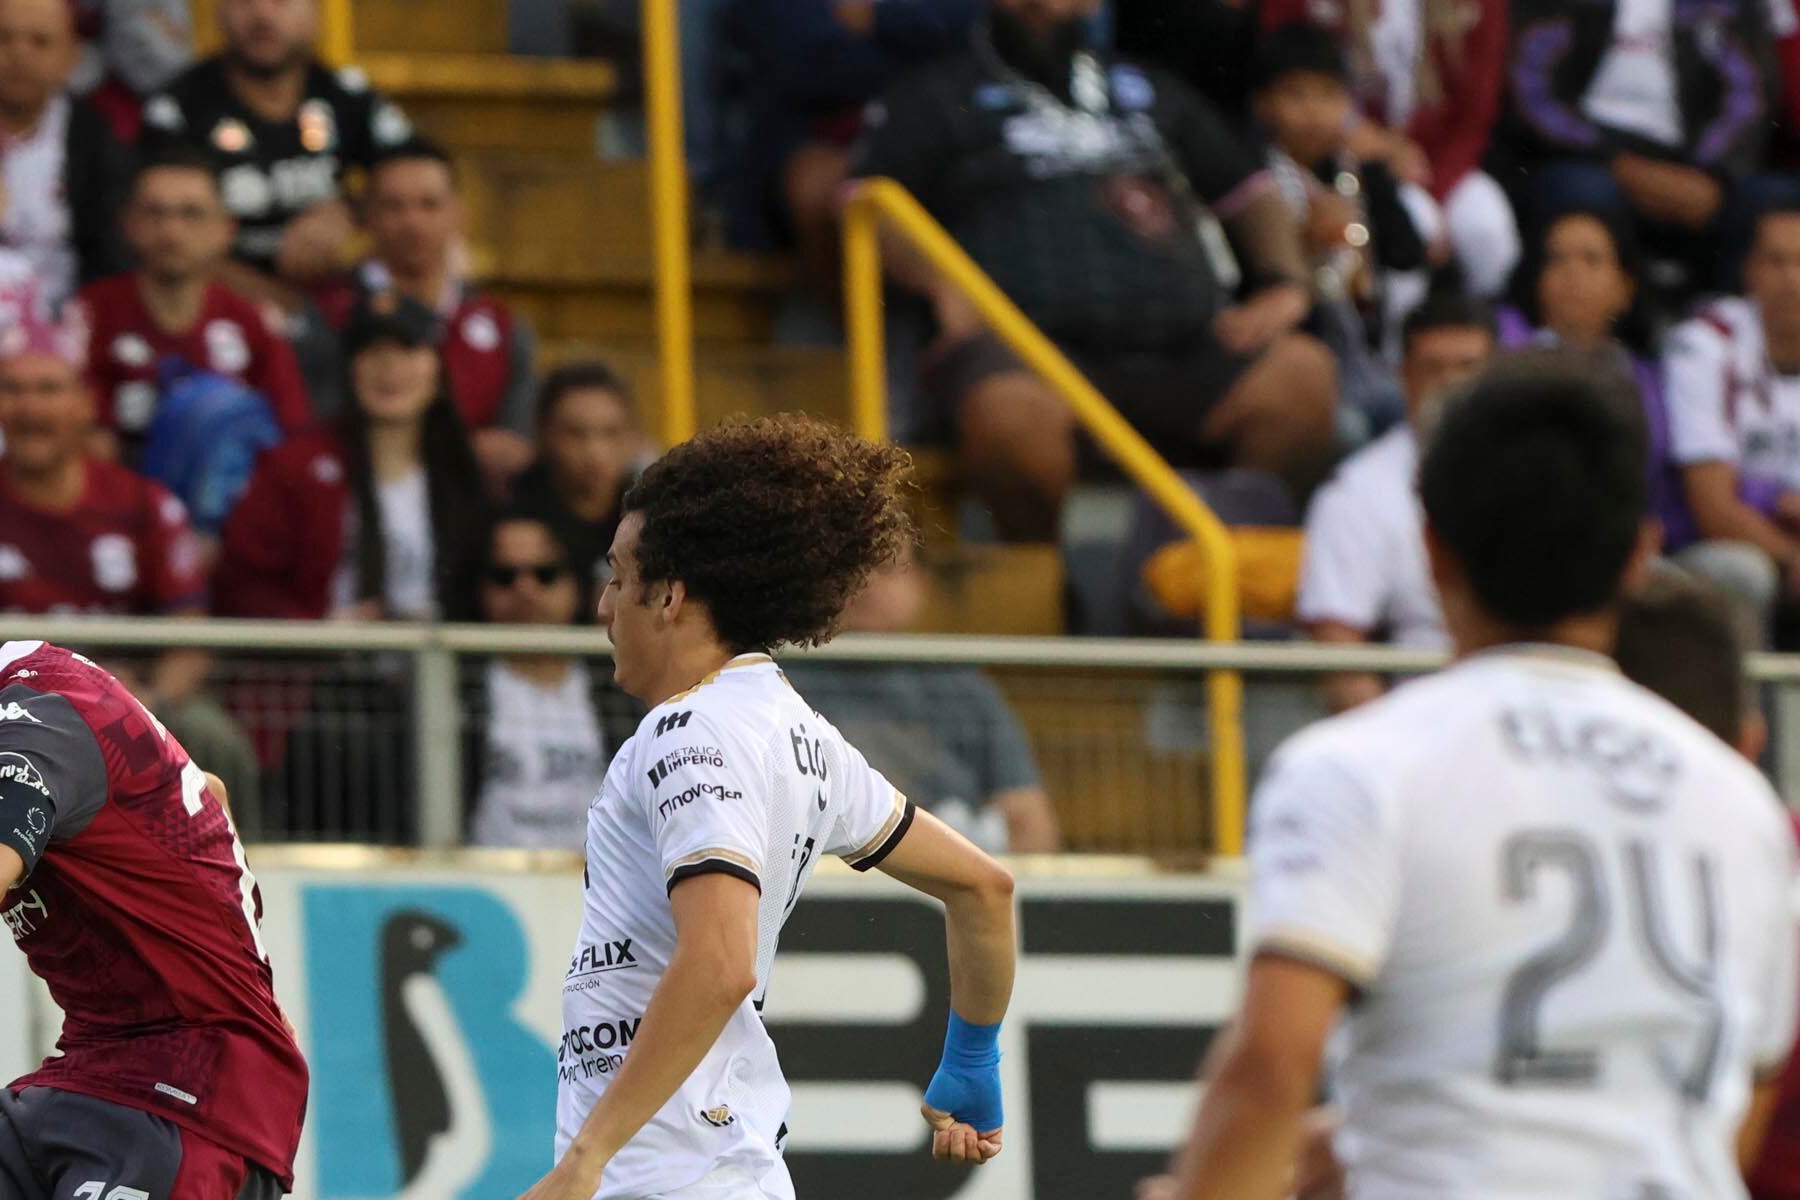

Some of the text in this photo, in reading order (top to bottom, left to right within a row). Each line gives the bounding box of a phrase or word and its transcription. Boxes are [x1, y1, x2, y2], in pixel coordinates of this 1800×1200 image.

[665, 746, 724, 763] METALICA
[667, 754, 725, 774] IMPERIO
[578, 937, 637, 973] FLIX
[1494, 824, 1720, 1104] 24
